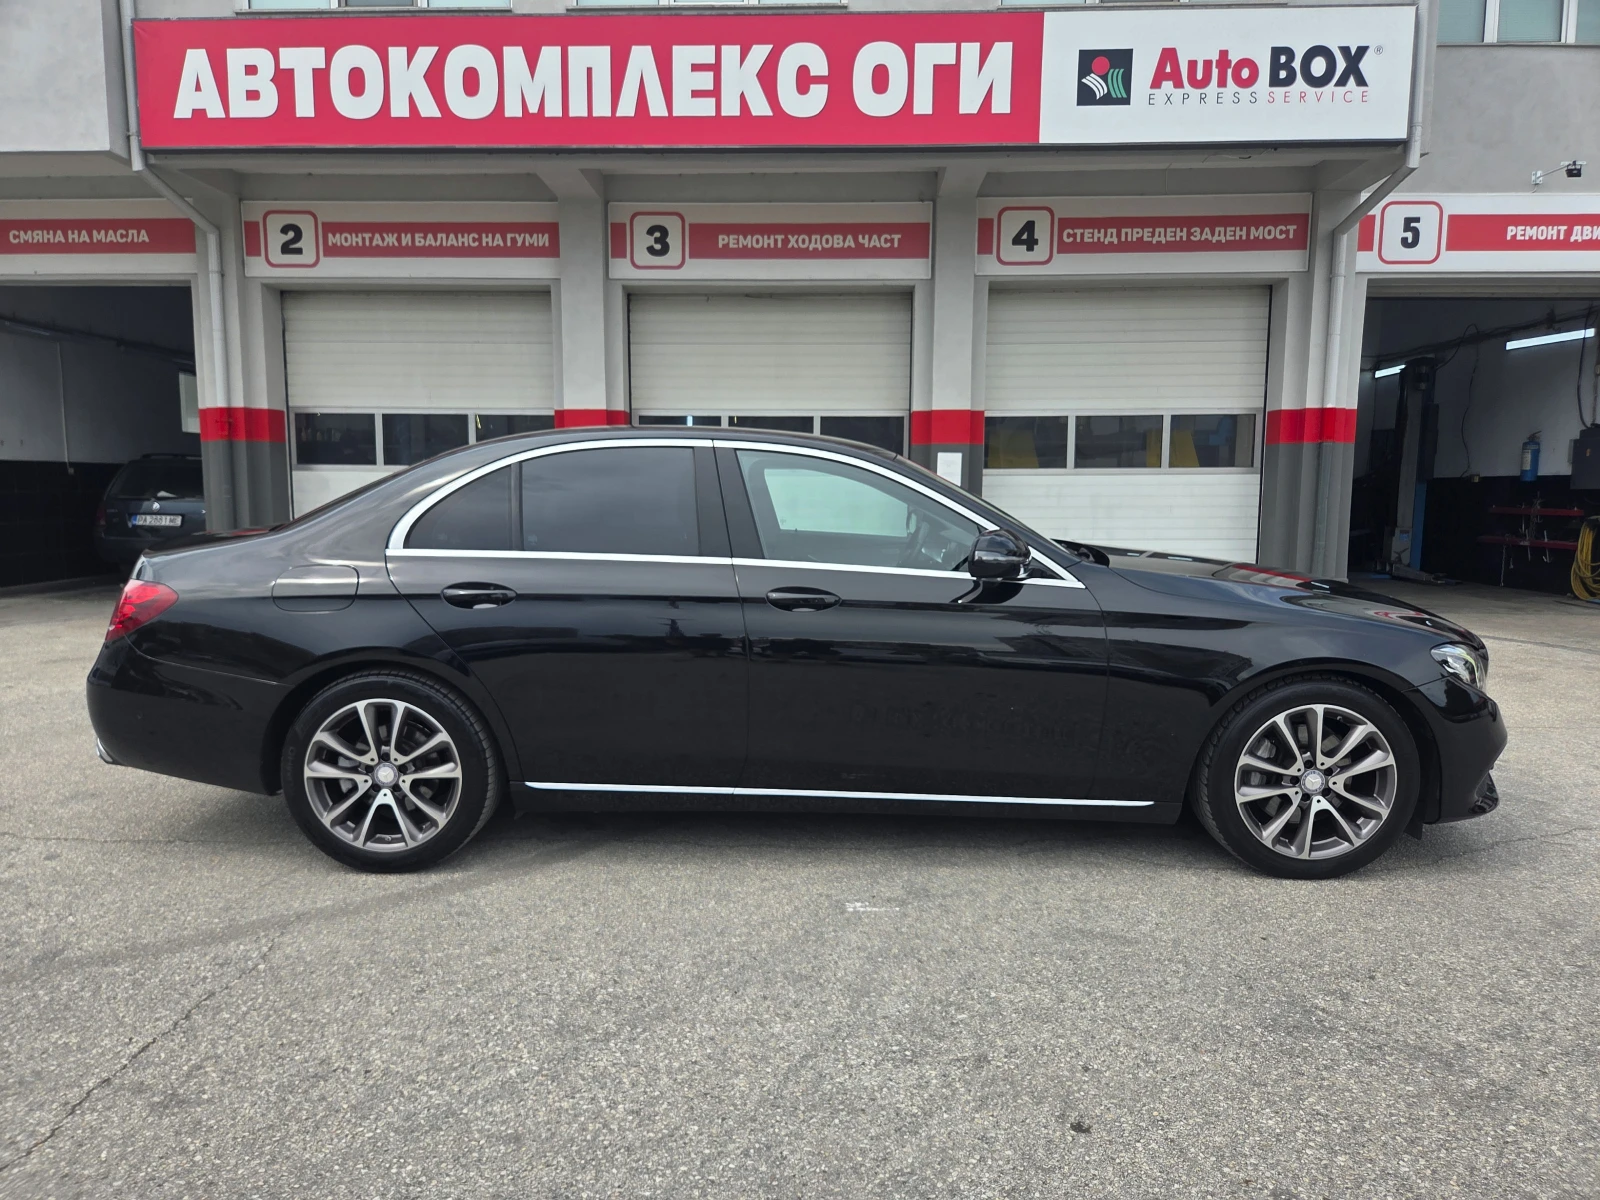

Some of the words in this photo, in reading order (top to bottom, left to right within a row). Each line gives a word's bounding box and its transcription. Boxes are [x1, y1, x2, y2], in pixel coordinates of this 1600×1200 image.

[173, 43, 830, 120] АВТОКОМПЛЕКС
[852, 40, 1013, 117] ОГИ
[1149, 47, 1259, 89] Auto
[1268, 45, 1370, 88] BOX
[9, 229, 66, 244] СМЯНА
[68, 229, 91, 243] НА
[93, 229, 150, 243] МАСЛА
[279, 223, 304, 256] 2
[327, 232, 399, 248] МОНТАЖ
[401, 232, 412, 248] И
[415, 232, 479, 248] БАЛАНС
[482, 232, 505, 247] НА
[506, 232, 549, 248] ГУМИ
[645, 224, 671, 258] 3
[718, 234, 785, 249] РЕМОНТ
[787, 234, 855, 251] ХОДОВА
[858, 234, 902, 249] ЧАСТ
[1011, 220, 1039, 252] 4
[1062, 228, 1118, 245] СТЕНД
[1120, 227, 1188, 244] ПРЕДЕН
[1190, 226, 1247, 242] ЗАДЕН
[1250, 225, 1298, 240] МОСТ
[1400, 216, 1421, 249] 5
[1506, 225, 1568, 241] РЕМОНТ
